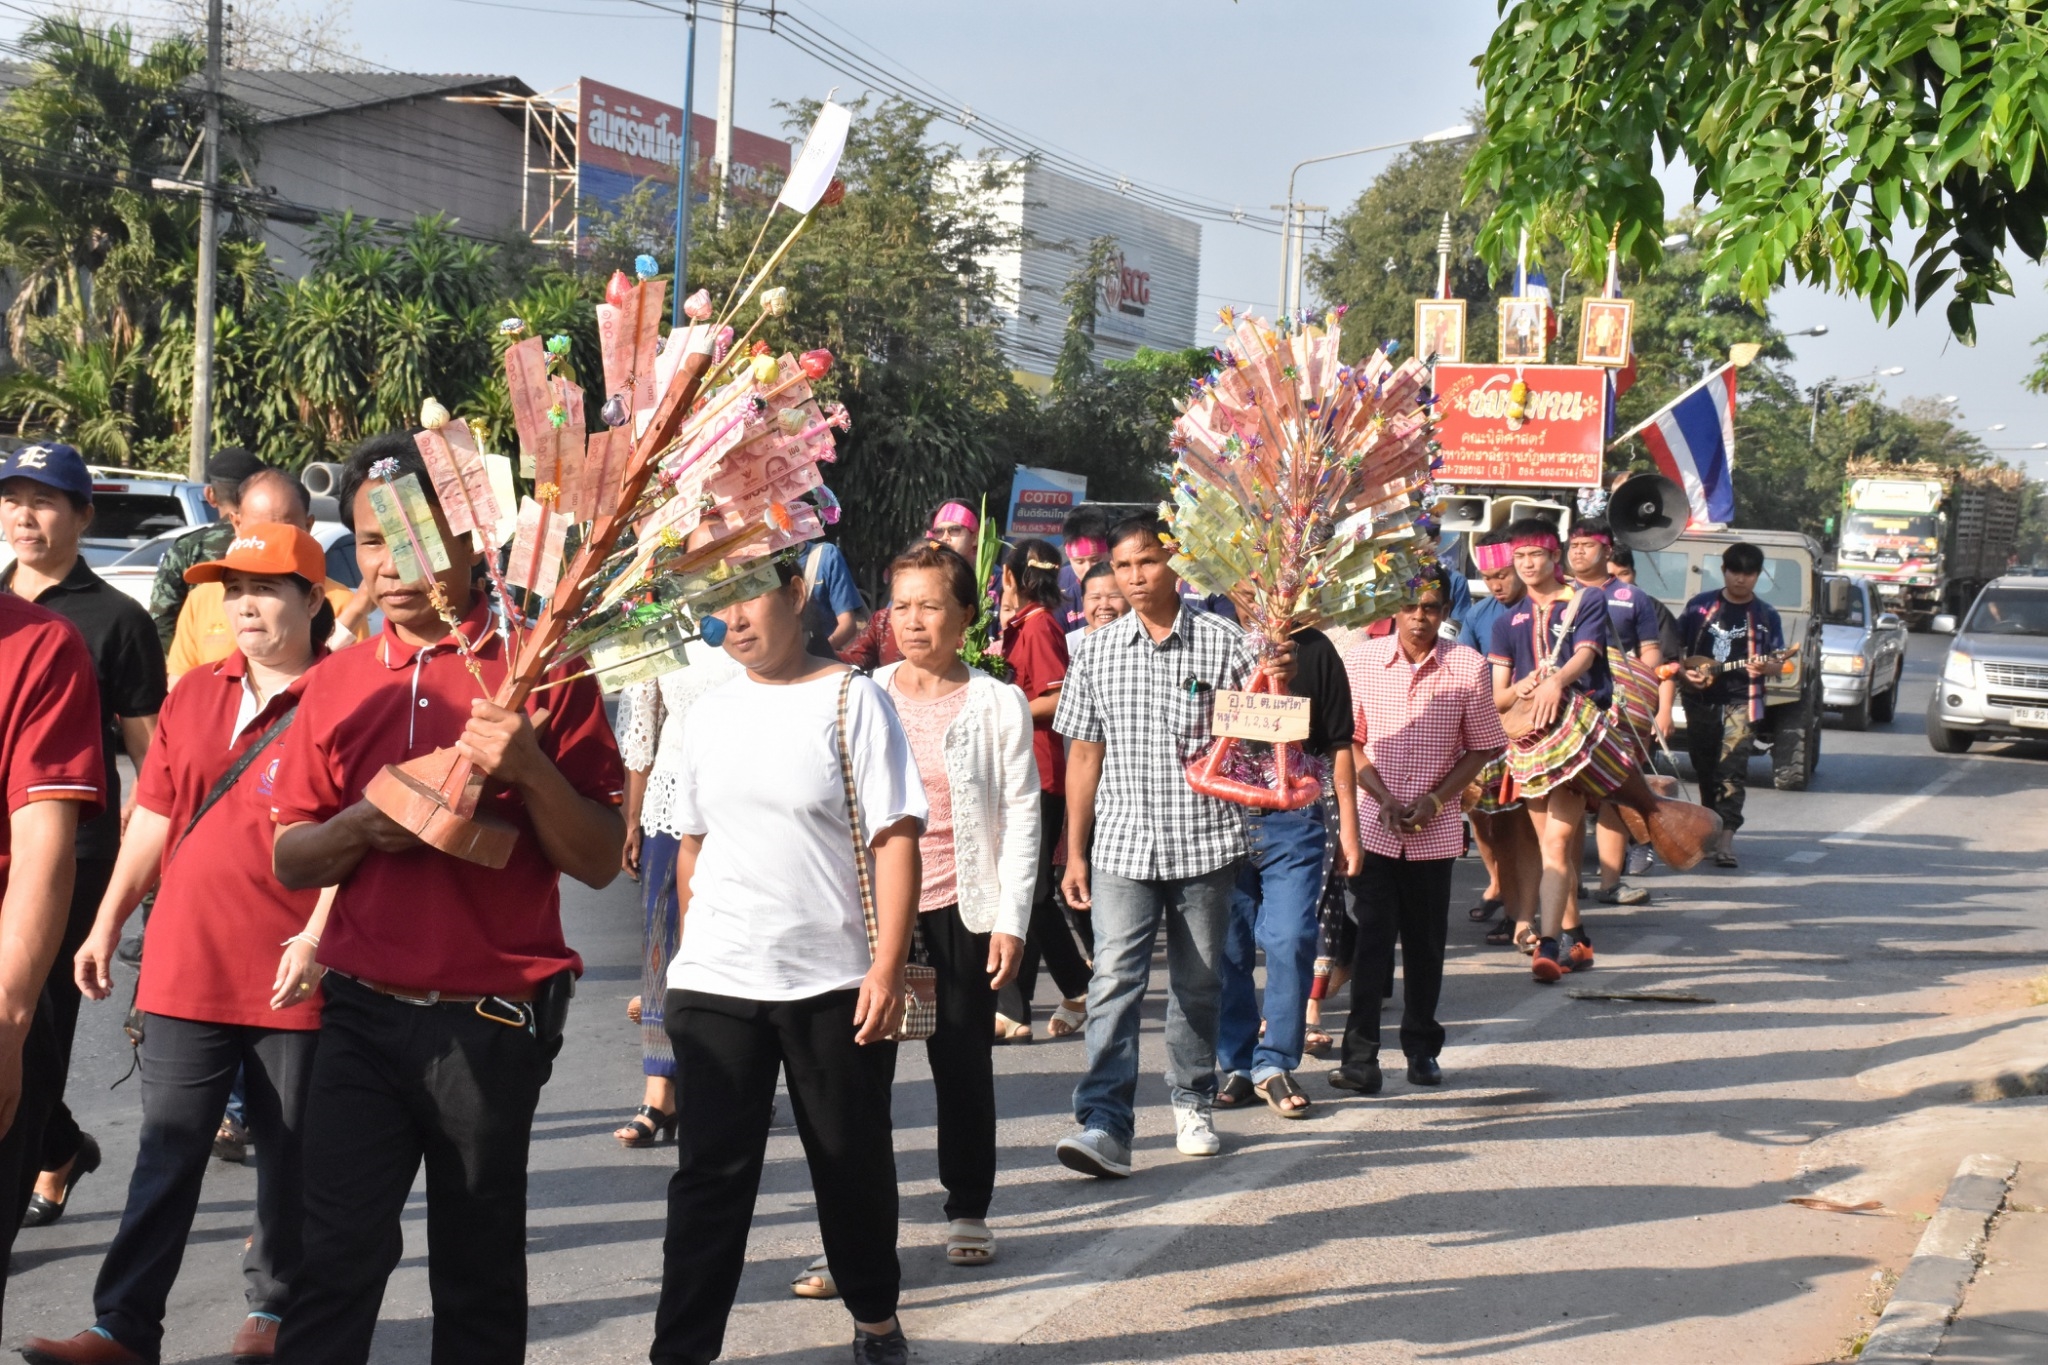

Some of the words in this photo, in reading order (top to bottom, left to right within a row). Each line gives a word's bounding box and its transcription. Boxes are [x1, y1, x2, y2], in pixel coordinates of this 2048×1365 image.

[1122, 266, 1150, 305] SCG
[787, 445, 800, 456] 100
[1024, 491, 1068, 504] COTTO
[789, 503, 802, 511] 100
